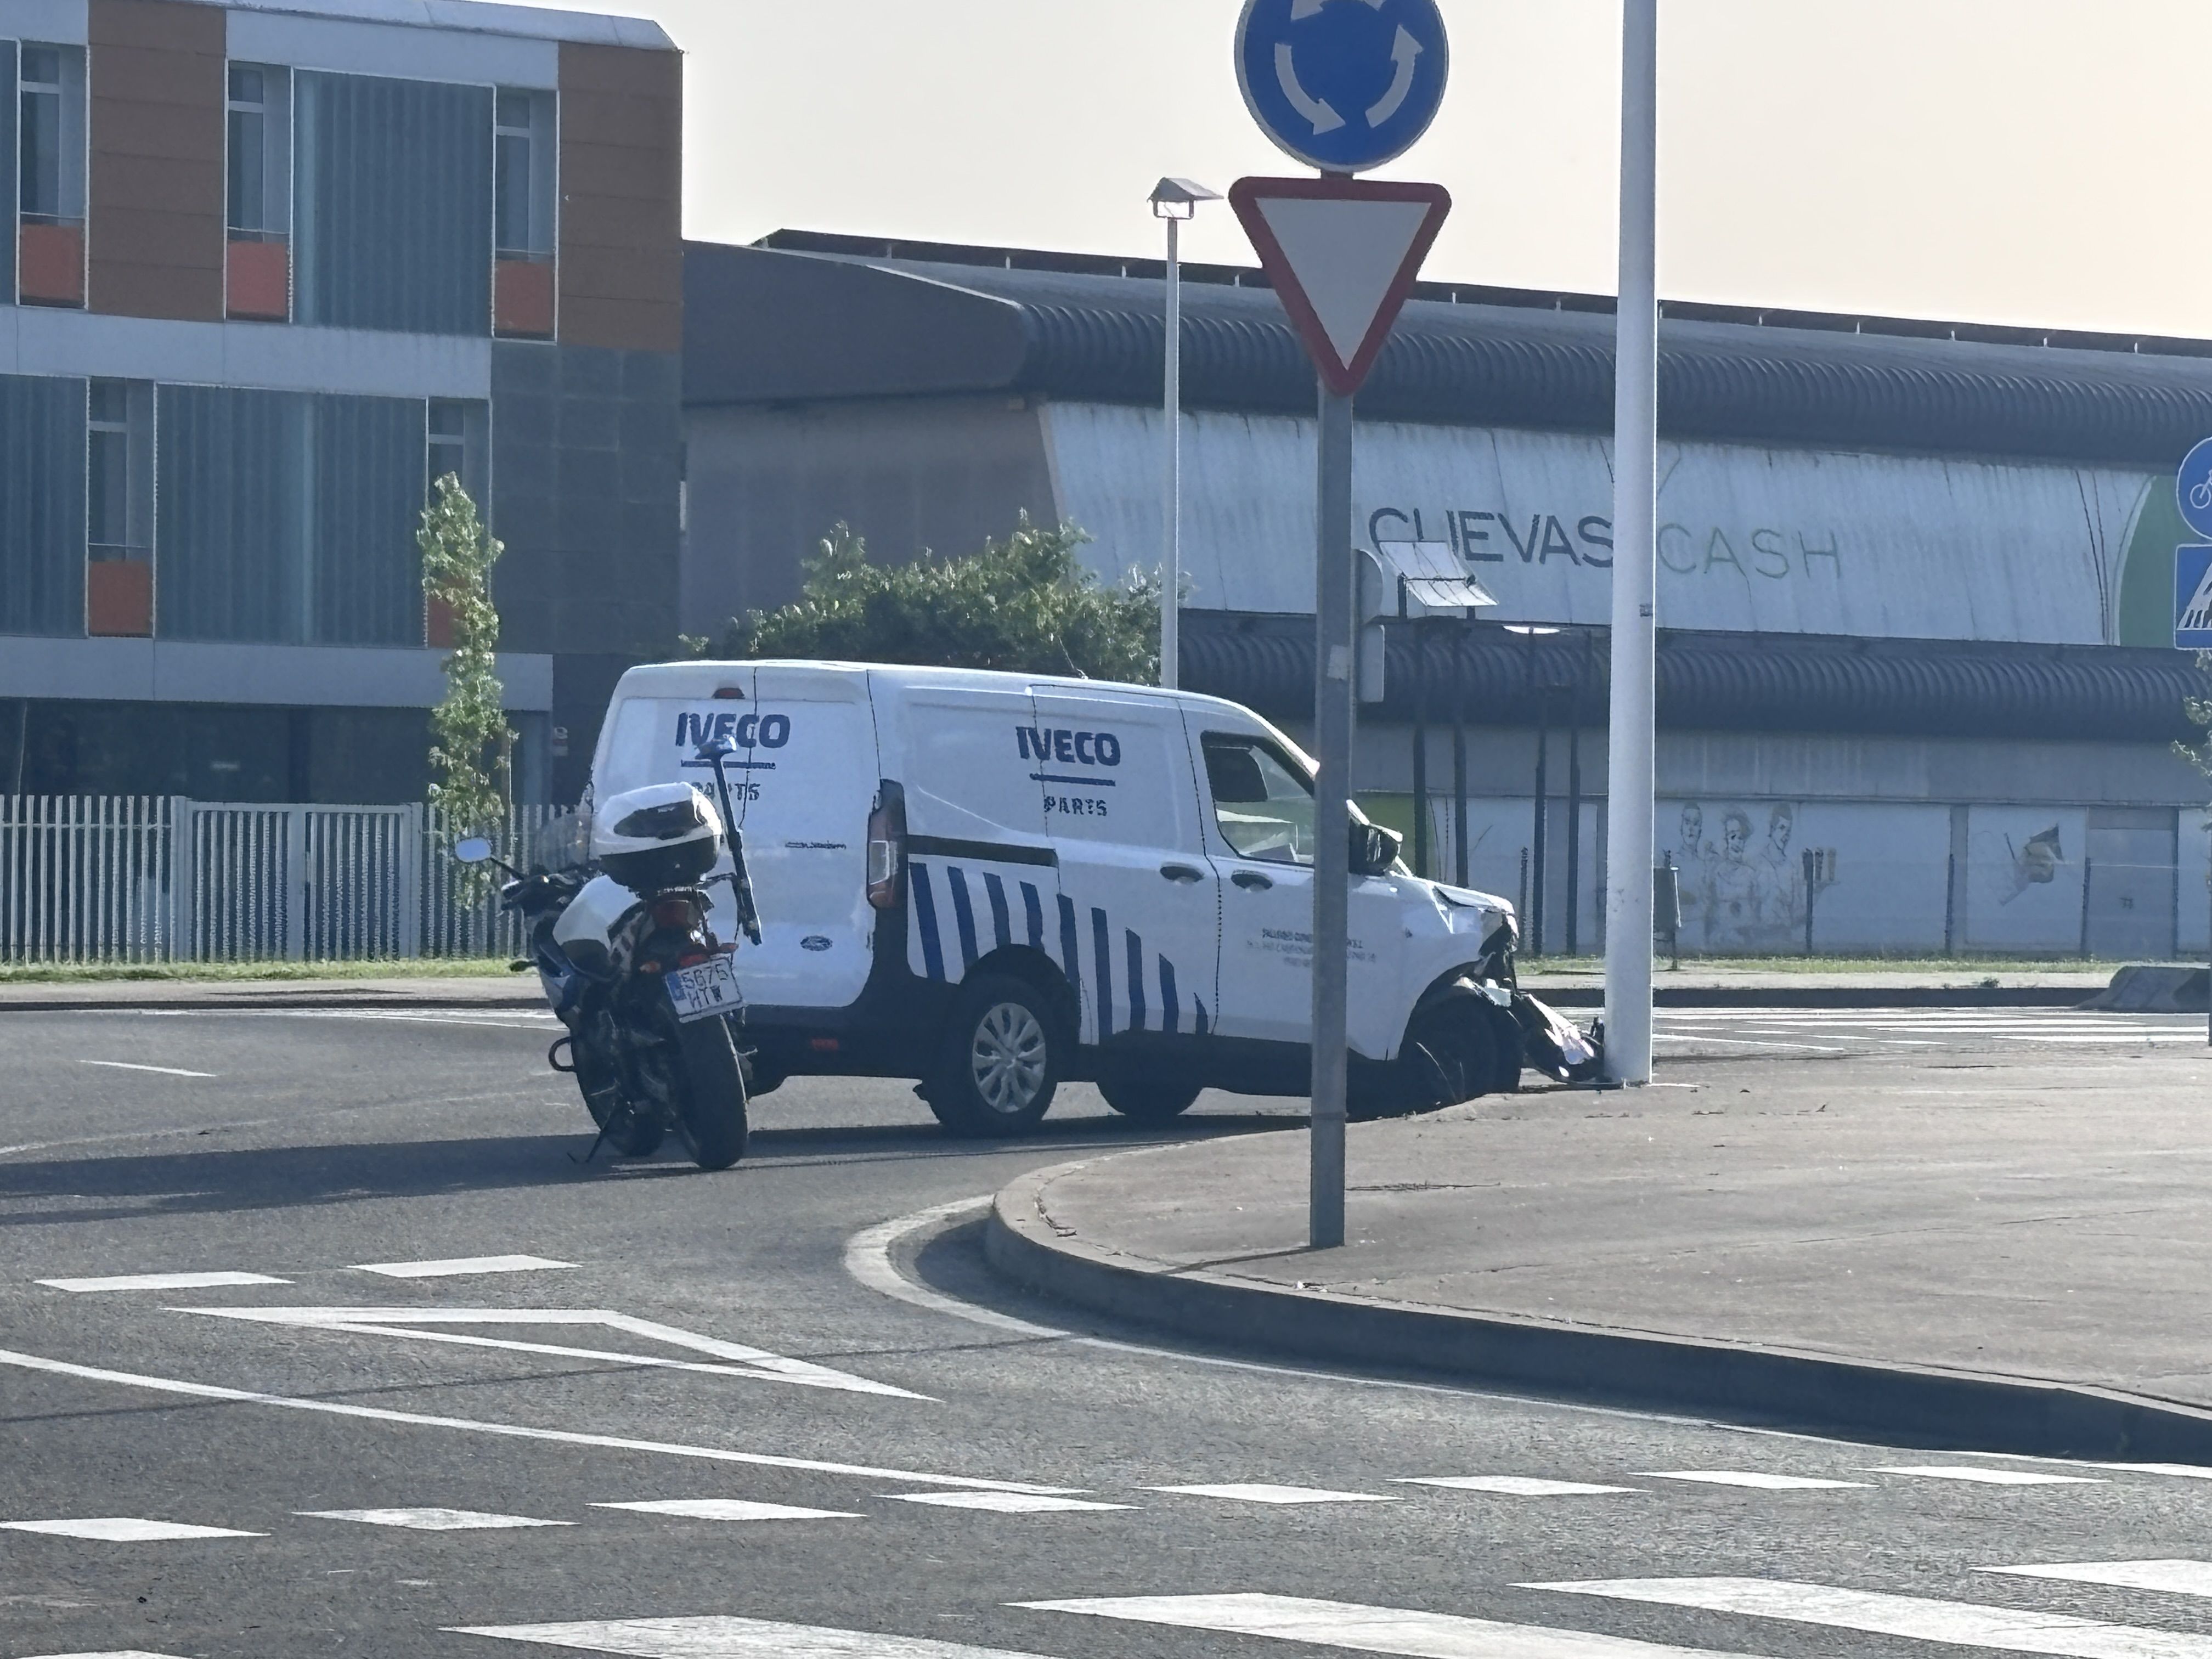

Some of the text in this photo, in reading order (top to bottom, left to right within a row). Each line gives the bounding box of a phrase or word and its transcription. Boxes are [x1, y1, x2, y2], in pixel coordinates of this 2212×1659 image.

[1658, 523, 1841, 579] CASH
[675, 713, 791, 748] IVECO
[1016, 726, 1120, 766] IVECO
[1044, 796, 1107, 816] PARTS
